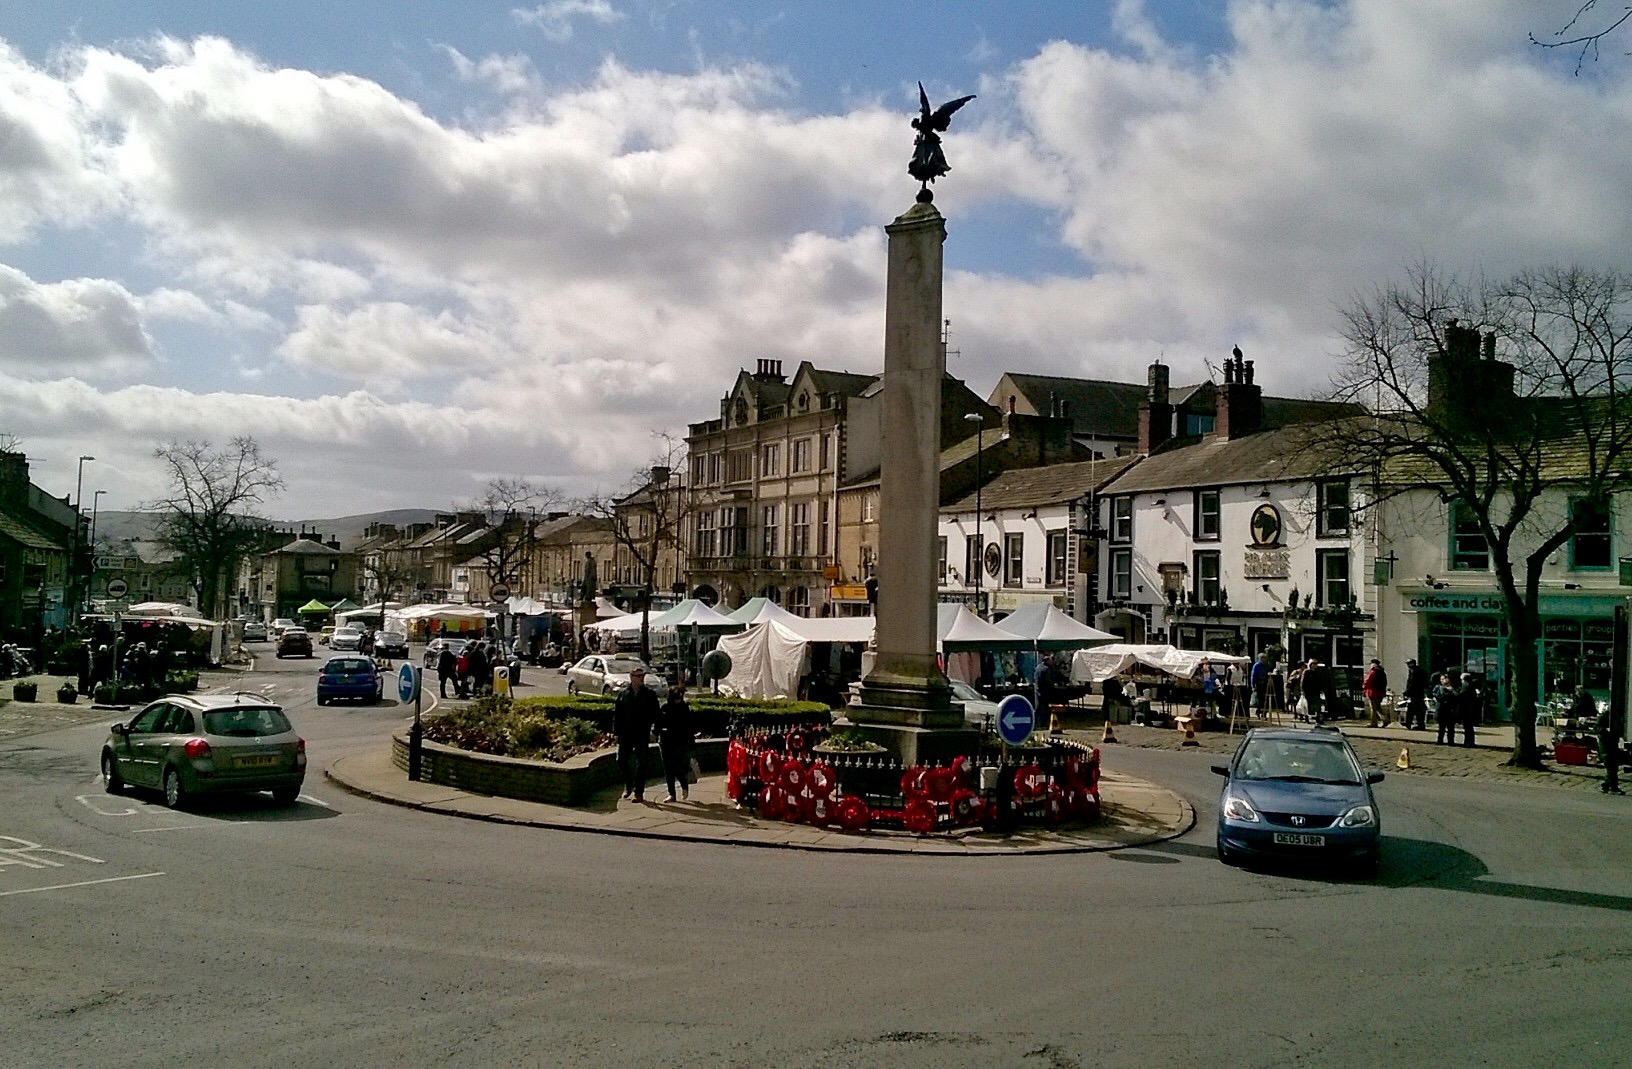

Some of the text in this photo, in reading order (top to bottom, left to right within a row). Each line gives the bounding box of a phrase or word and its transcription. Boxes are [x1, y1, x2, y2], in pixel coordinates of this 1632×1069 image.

[1410, 596, 1505, 611] coffee and clay
[1545, 624, 1579, 635] parties
